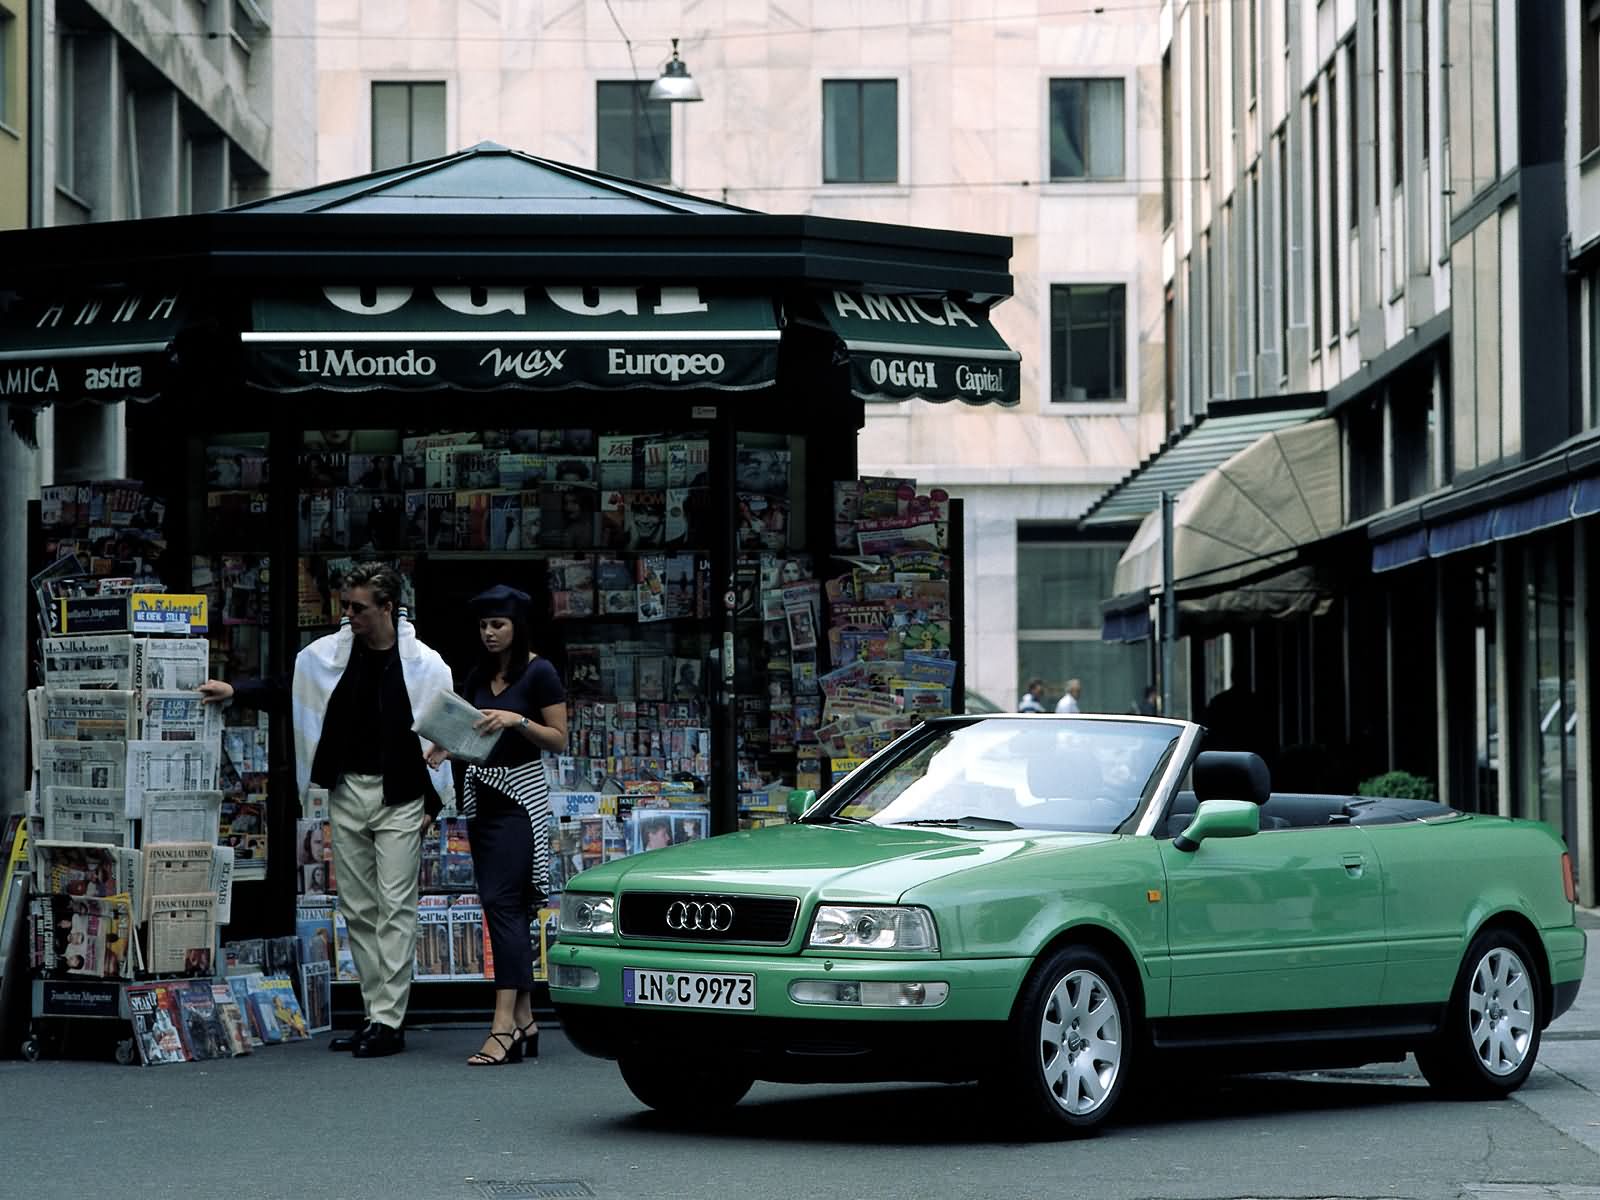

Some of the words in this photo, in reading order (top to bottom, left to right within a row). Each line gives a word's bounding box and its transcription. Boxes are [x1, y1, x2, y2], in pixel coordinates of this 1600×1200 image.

[84, 361, 143, 391] astra
[321, 350, 437, 377] Mondo
[607, 348, 725, 381] Europeo
[870, 358, 938, 388] OGGI
[955, 364, 1004, 396] Capital
[638, 973, 664, 1000] IN
[677, 976, 691, 1003] C
[695, 977, 751, 1006] 9973
